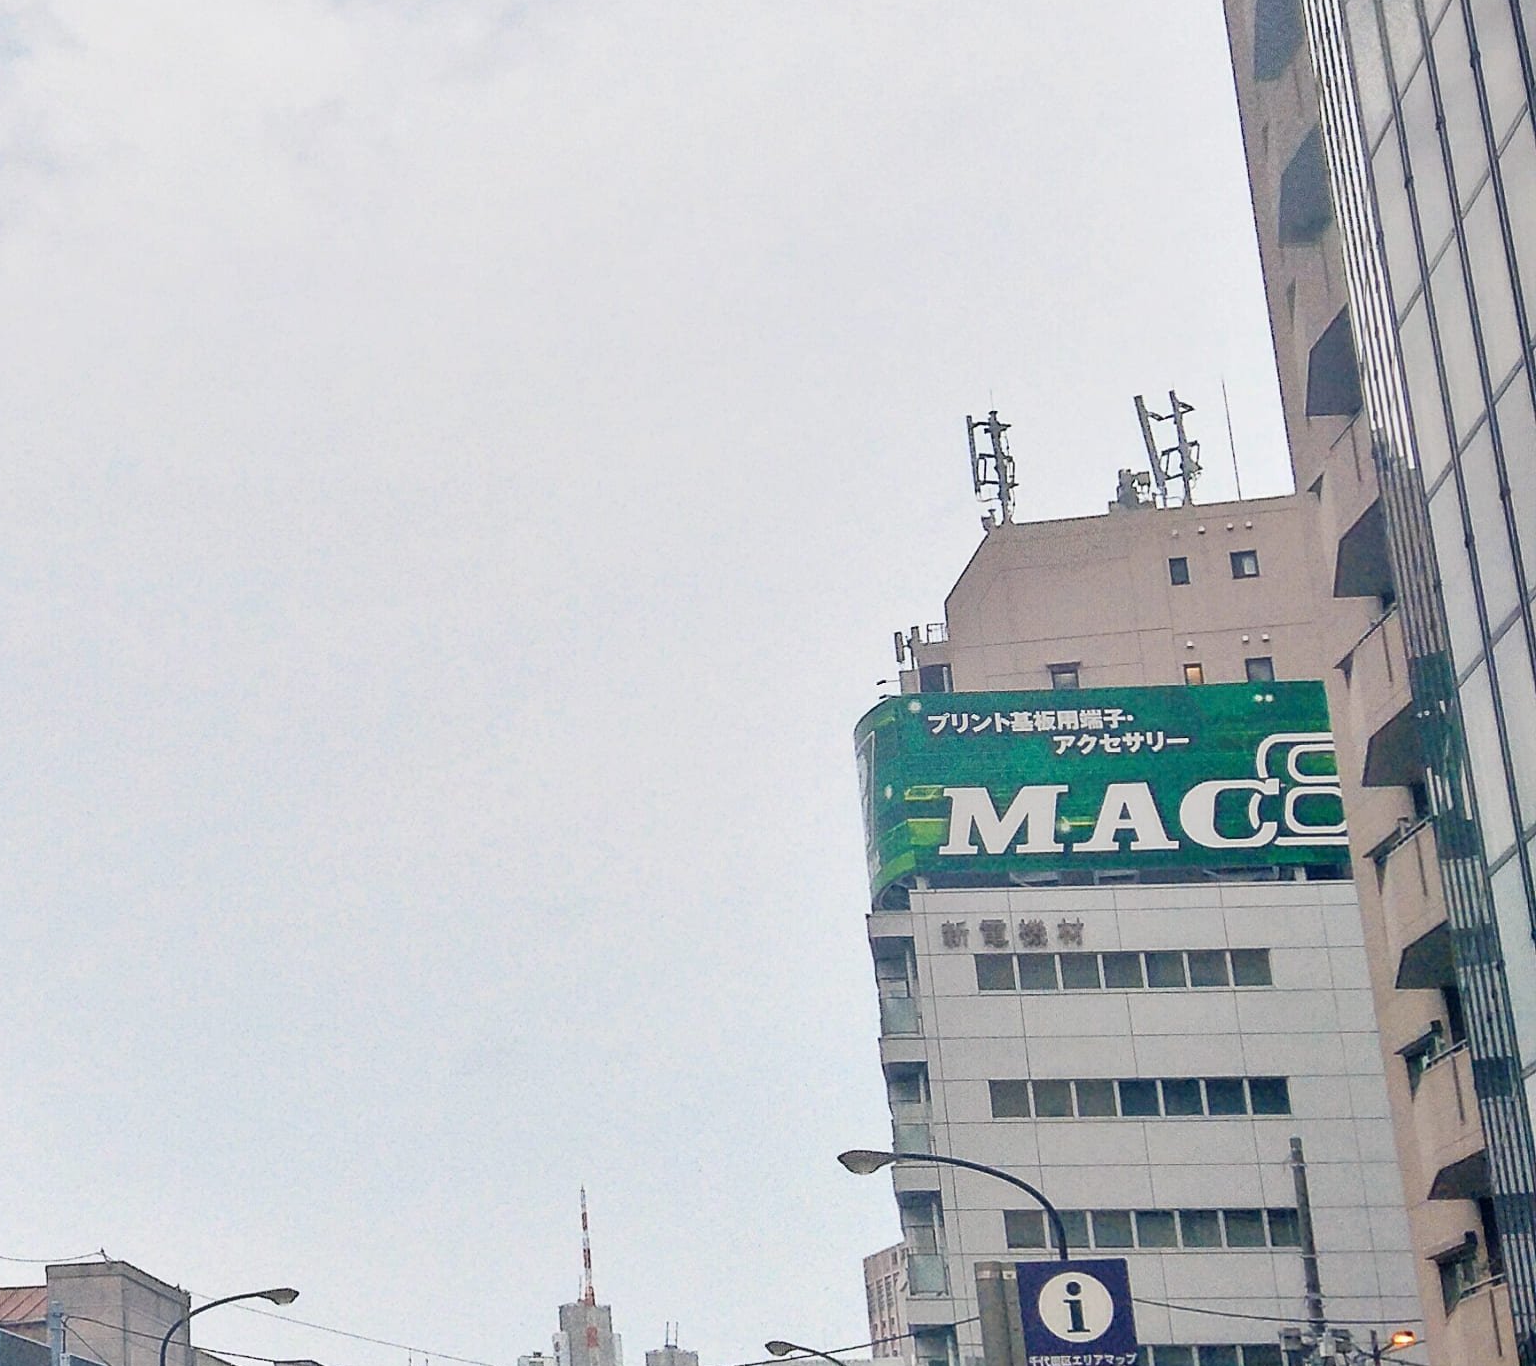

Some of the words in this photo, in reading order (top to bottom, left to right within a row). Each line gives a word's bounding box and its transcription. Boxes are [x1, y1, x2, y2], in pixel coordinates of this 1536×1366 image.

[1053, 731, 1189, 754] アクセサリー
